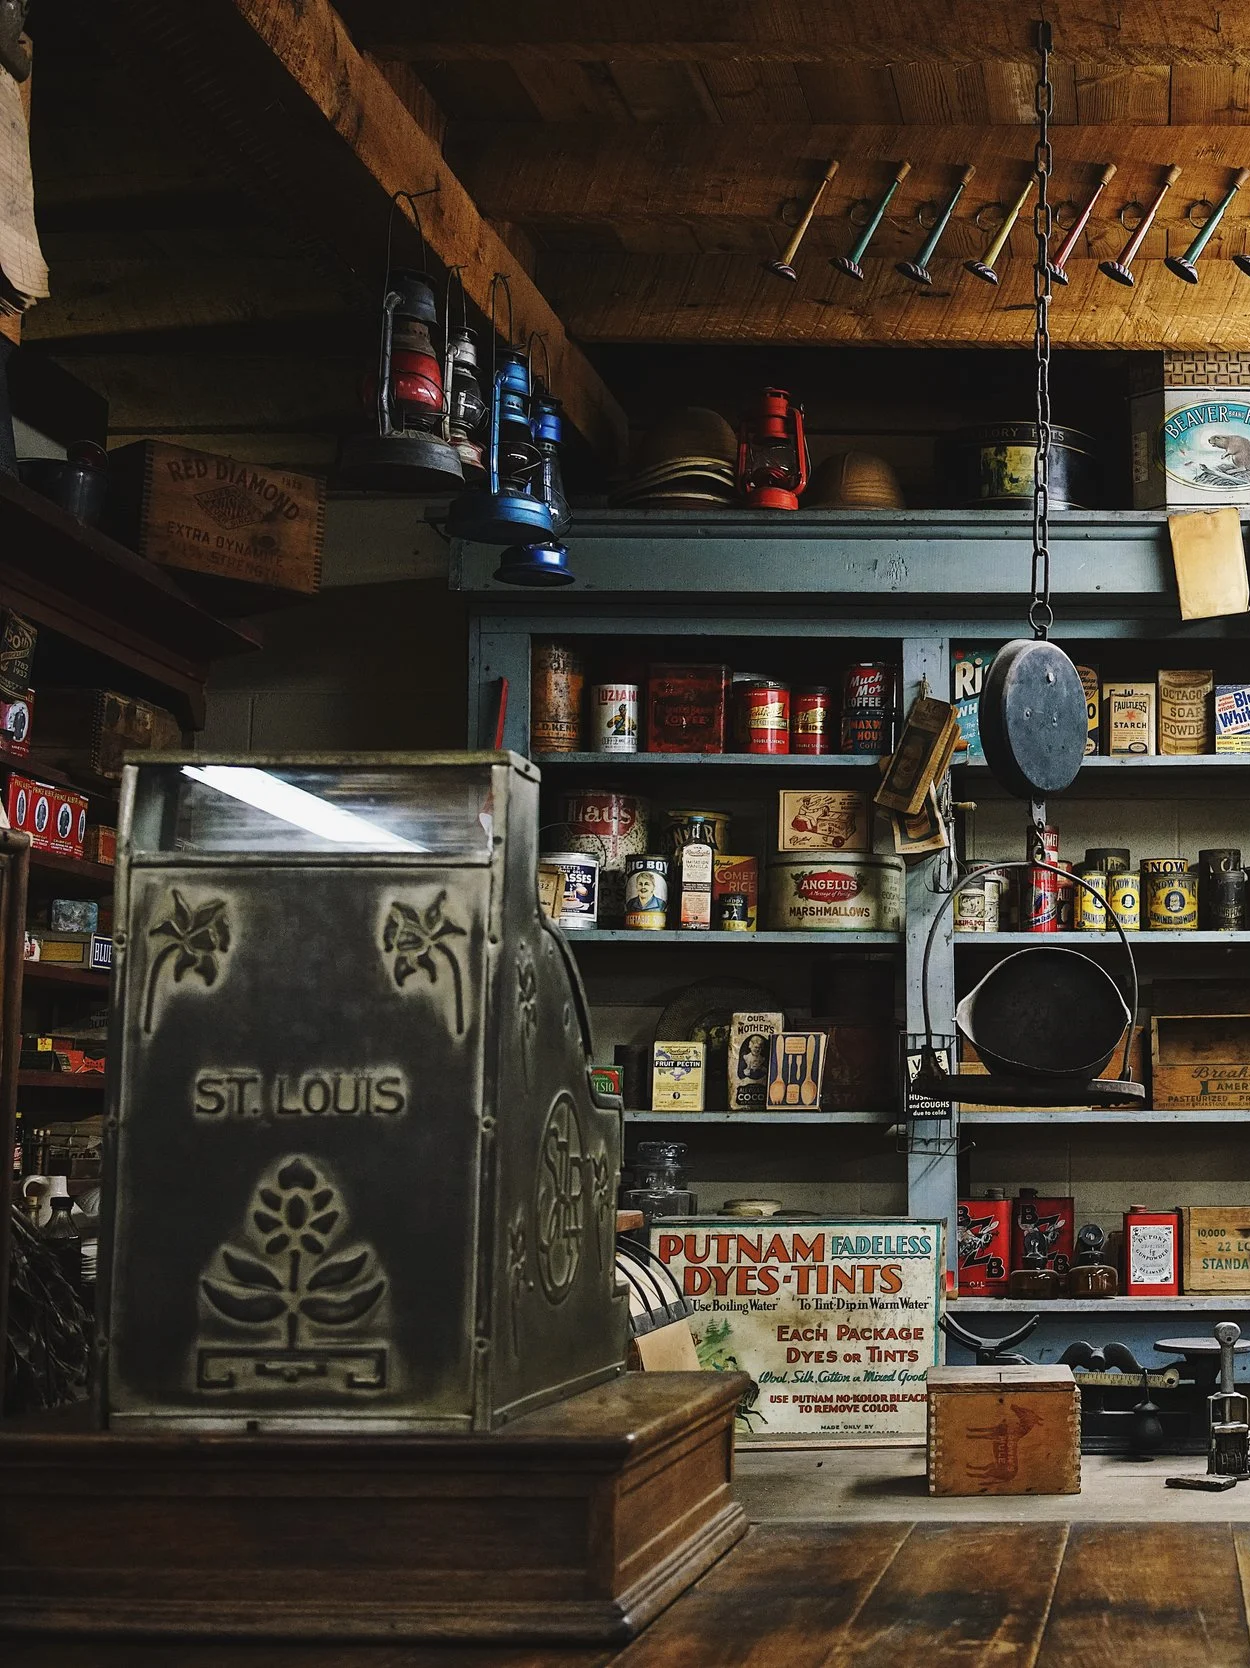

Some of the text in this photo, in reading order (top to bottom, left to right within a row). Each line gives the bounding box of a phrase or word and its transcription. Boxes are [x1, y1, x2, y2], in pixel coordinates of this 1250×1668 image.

[1164, 405, 1230, 439] BEAVER
[1229, 411, 1245, 419] BRAND
[167, 459, 207, 482] RED
[216, 460, 299, 520] DIAMOND
[167, 521, 284, 567] EXTRA DYNAMITE
[207, 552, 281, 579] STRENGTH
[850, 672, 883, 689] Much
[855, 683, 887, 698] More
[1114, 701, 1147, 714] FAULTLESS
[627, 860, 669, 874] BIG BOY
[1144, 861, 1186, 873] SNOW
[715, 868, 756, 884] COMET
[729, 882, 755, 892] RICE
[801, 880, 858, 891] ANGELUS
[1150, 880, 1174, 895] SNOW
[789, 907, 871, 918] MARSHMALLOWS
[737, 1023, 775, 1035] MOTHER'S
[276, 1074, 408, 1116] LOUIS
[1168, 1095, 1228, 1103] PASTEURIZED
[920, 1101, 950, 1109] COUGHS
[1198, 1229, 1226, 1238] 10,000
[658, 1233, 932, 1265] PUTNAM FADELESS
[1217, 1242, 1232, 1252] 22
[1135, 1249, 1169, 1262] GUNPOWDER
[711, 1298, 749, 1315] Boiling
[858, 1297, 868, 1311] in
[868, 1298, 899, 1311] Warm
[777, 1324, 925, 1342] EACH PACKAGE
[786, 1346, 919, 1364] DYES OR TINTS
[817, 1370, 851, 1385] Cotton
[863, 1369, 895, 1383] Mixed
[769, 1394, 789, 1404] USE
[792, 1394, 834, 1404] PUTNAM
[889, 1392, 929, 1403] BLEACH
[798, 1403, 899, 1414] TO REMOVE COLOR
